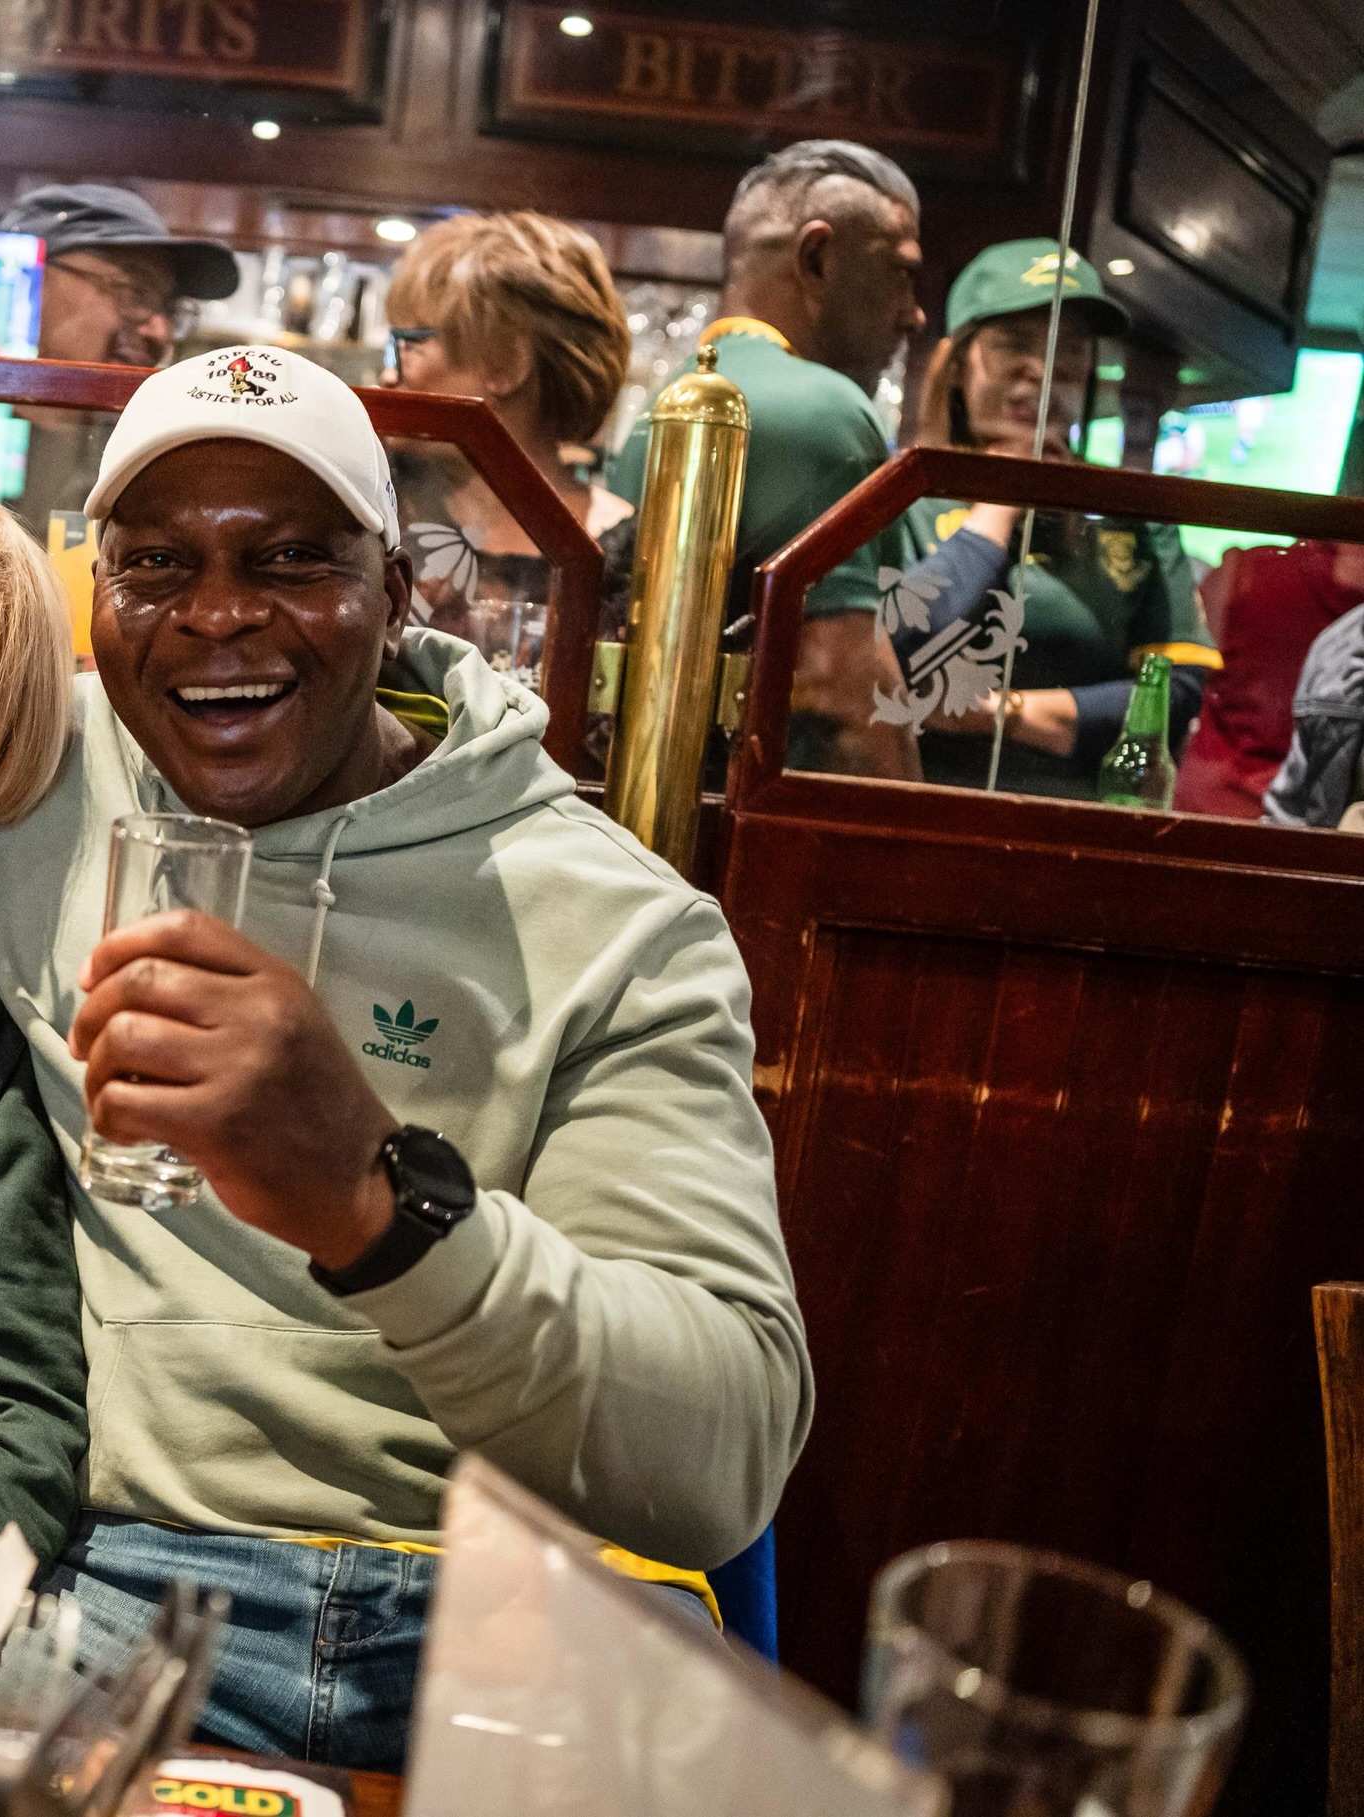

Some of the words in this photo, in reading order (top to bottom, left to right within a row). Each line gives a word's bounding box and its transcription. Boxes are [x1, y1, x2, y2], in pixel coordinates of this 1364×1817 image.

[618, 32, 917, 124] BITTER
[252, 369, 277, 383] 89
[186, 386, 241, 404] JUSTICE
[245, 397, 278, 408] FOR
[279, 391, 299, 405] ALL
[361, 1041, 432, 1069] adidas
[151, 1778, 287, 1817] GOLD
